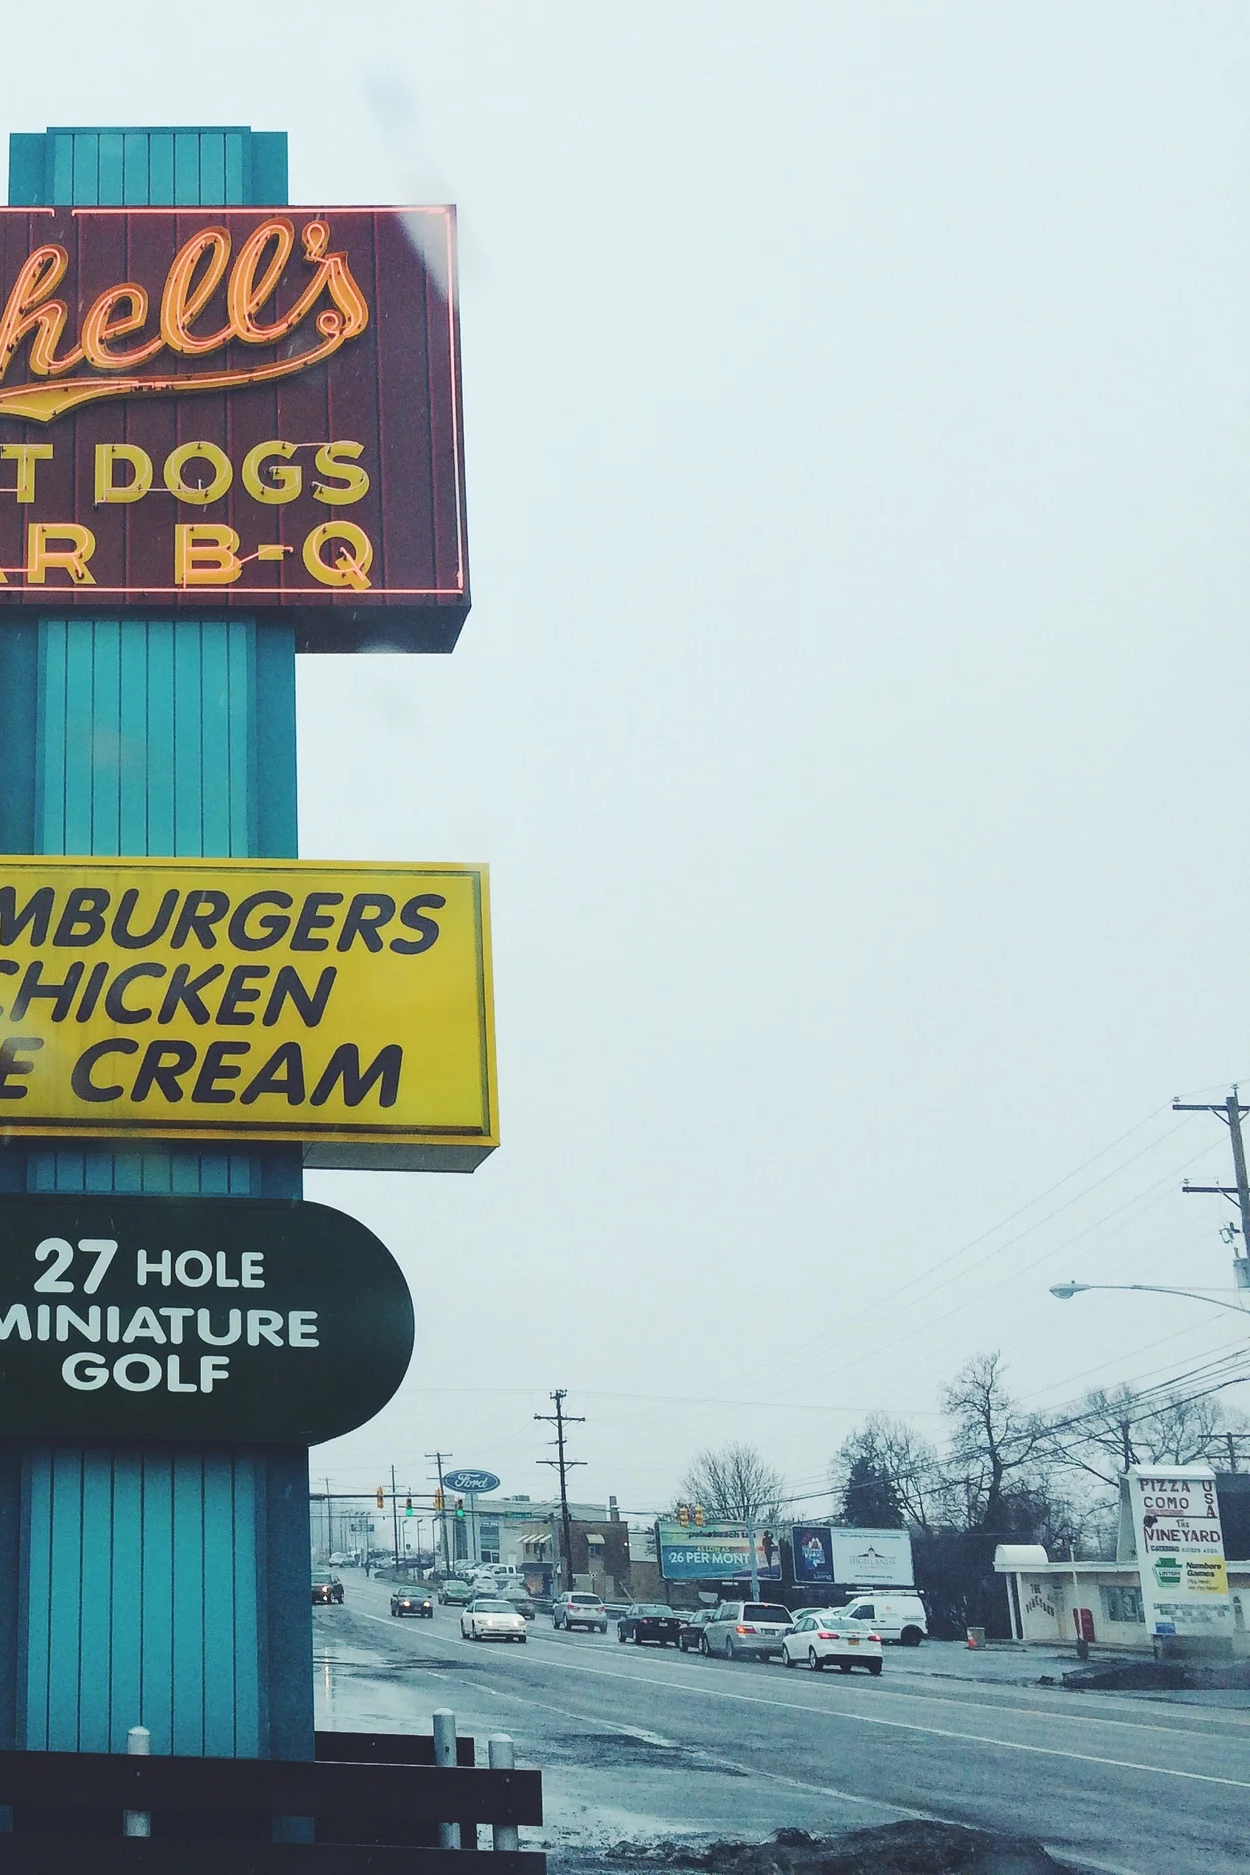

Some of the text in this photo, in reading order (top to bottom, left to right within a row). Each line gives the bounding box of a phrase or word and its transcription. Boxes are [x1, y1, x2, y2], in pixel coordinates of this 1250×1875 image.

[95, 440, 373, 505] DOGS
[174, 520, 374, 590] B-Q
[69, 1038, 404, 1109] CREAM
[32, 1237, 266, 1295] 27 HOLE
[61, 1351, 230, 1393] GOLF
[454, 1473, 489, 1488] Ford
[1139, 1479, 1191, 1493] PIZZA
[1143, 1496, 1190, 1509] COMO
[1144, 1528, 1221, 1543] VINEYARD
[686, 1552, 710, 1563] PER
[1186, 1569, 1215, 1577] Games
